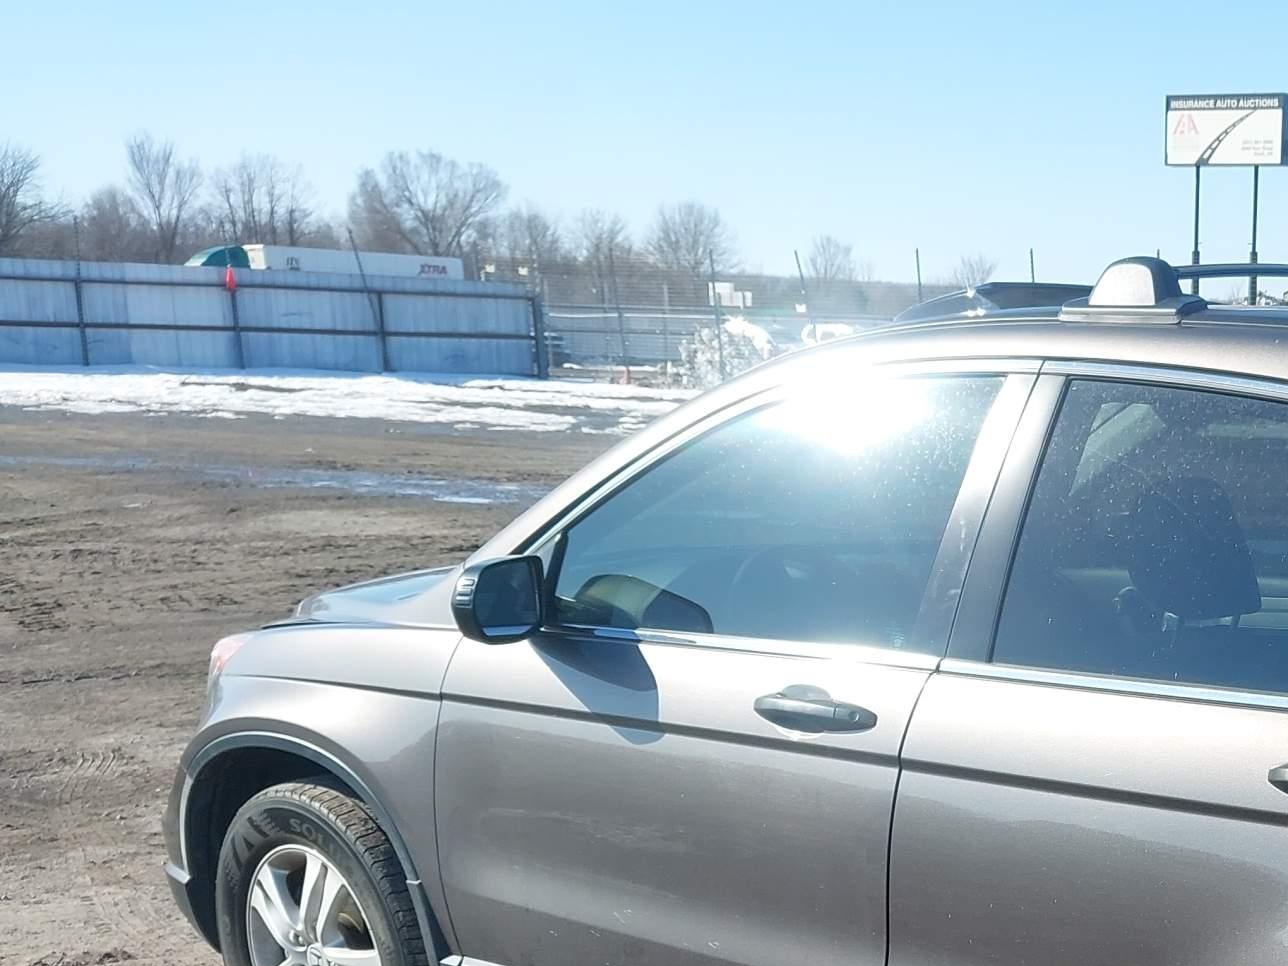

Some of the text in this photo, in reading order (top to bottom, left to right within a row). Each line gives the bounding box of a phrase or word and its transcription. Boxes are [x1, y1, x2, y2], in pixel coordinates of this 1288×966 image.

[1170, 97, 1279, 110] INSURANCE AUTO AUCTIONS
